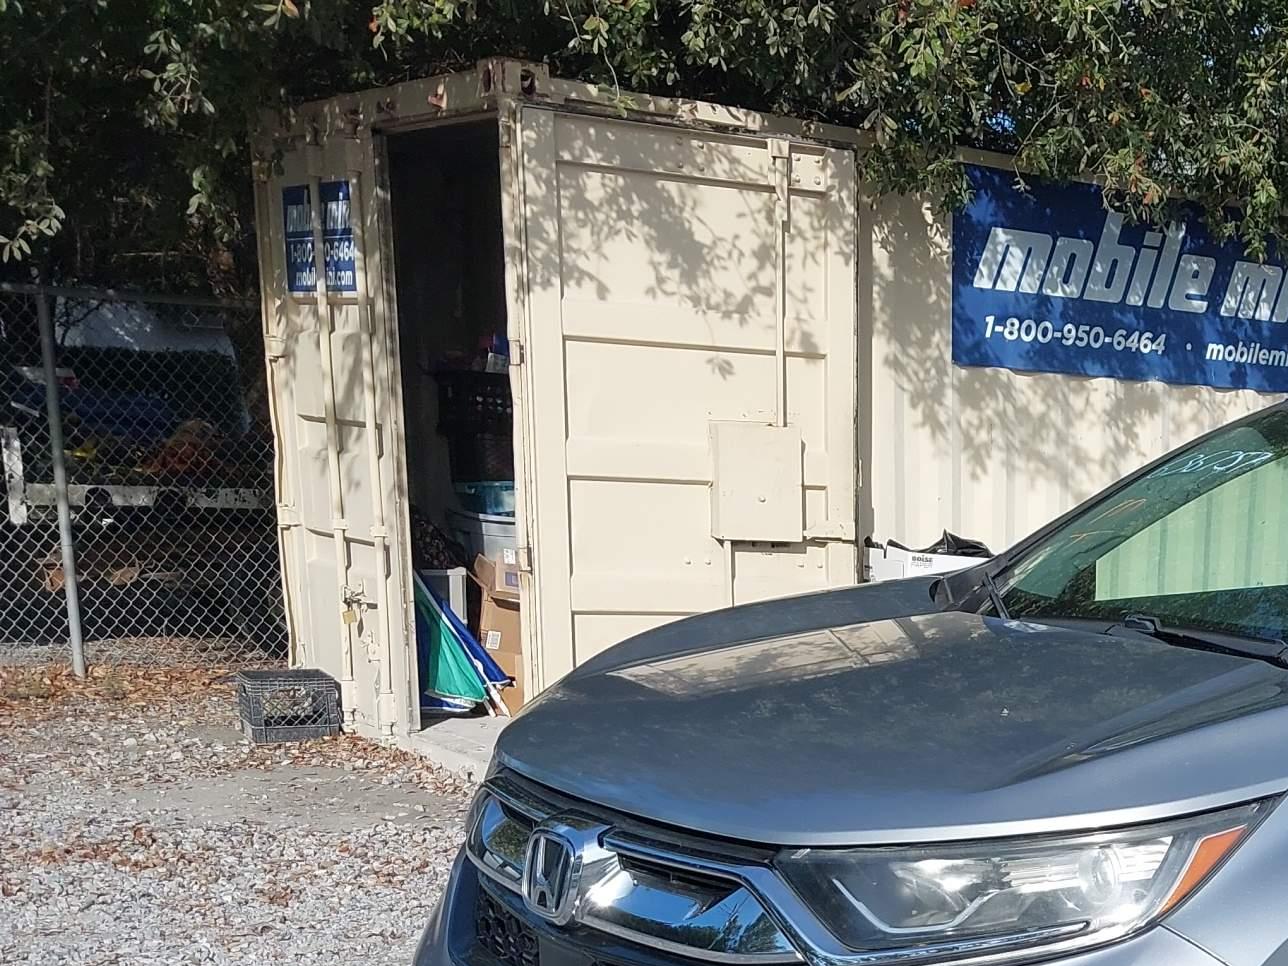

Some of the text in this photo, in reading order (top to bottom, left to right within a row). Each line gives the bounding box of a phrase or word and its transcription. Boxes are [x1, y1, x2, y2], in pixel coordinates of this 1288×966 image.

[290, 241, 355, 263] 1-800-0-6464
[973, 211, 1216, 314] mobile
[295, 266, 353, 286] mobilini.com
[984, 315, 1166, 355] 1-800-950-6464
